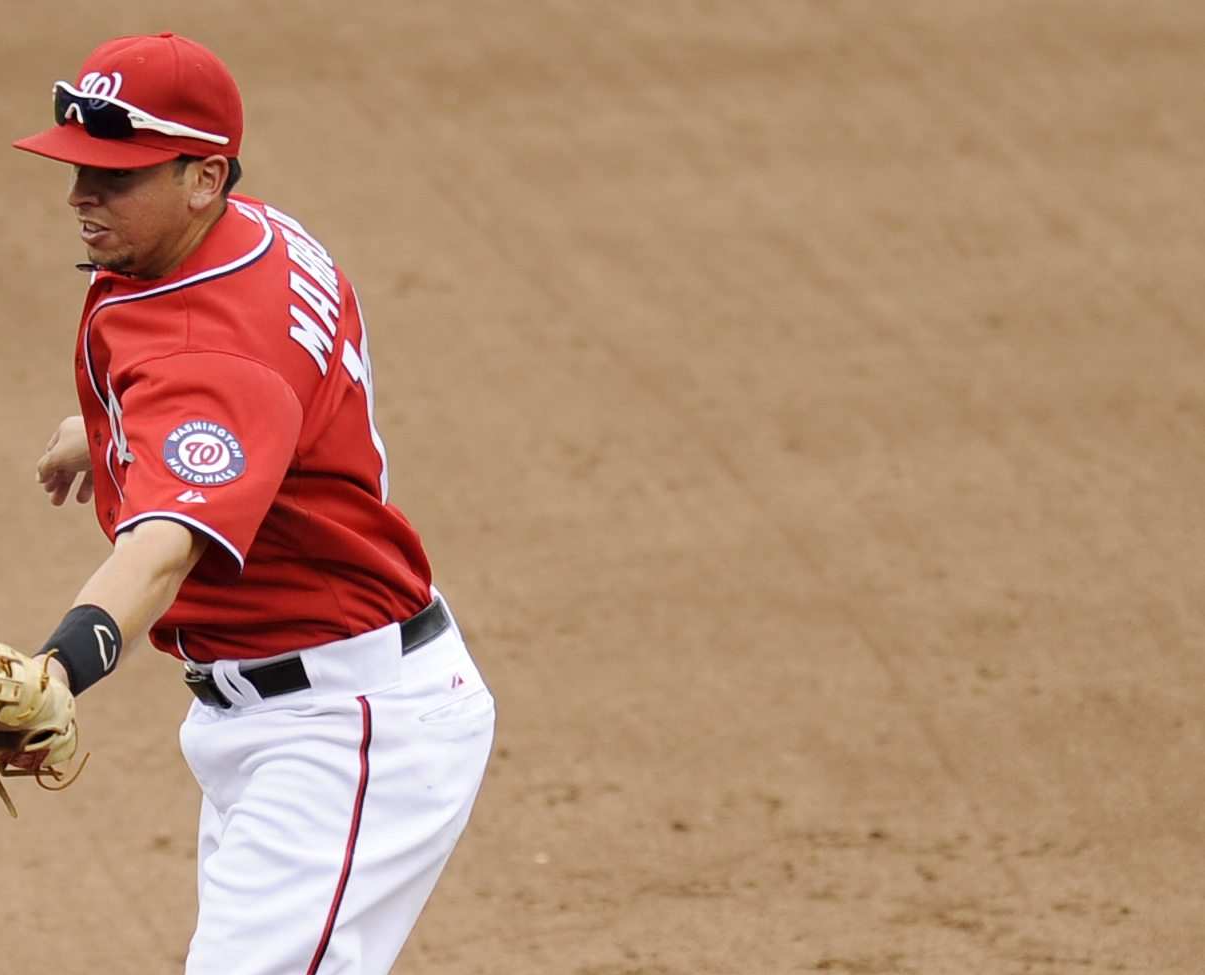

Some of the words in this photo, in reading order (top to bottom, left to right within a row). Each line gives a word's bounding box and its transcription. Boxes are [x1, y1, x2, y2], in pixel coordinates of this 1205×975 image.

[168, 421, 244, 459] WASHINGTON
[185, 441, 223, 466] W
[166, 457, 238, 484] NATIONALS
